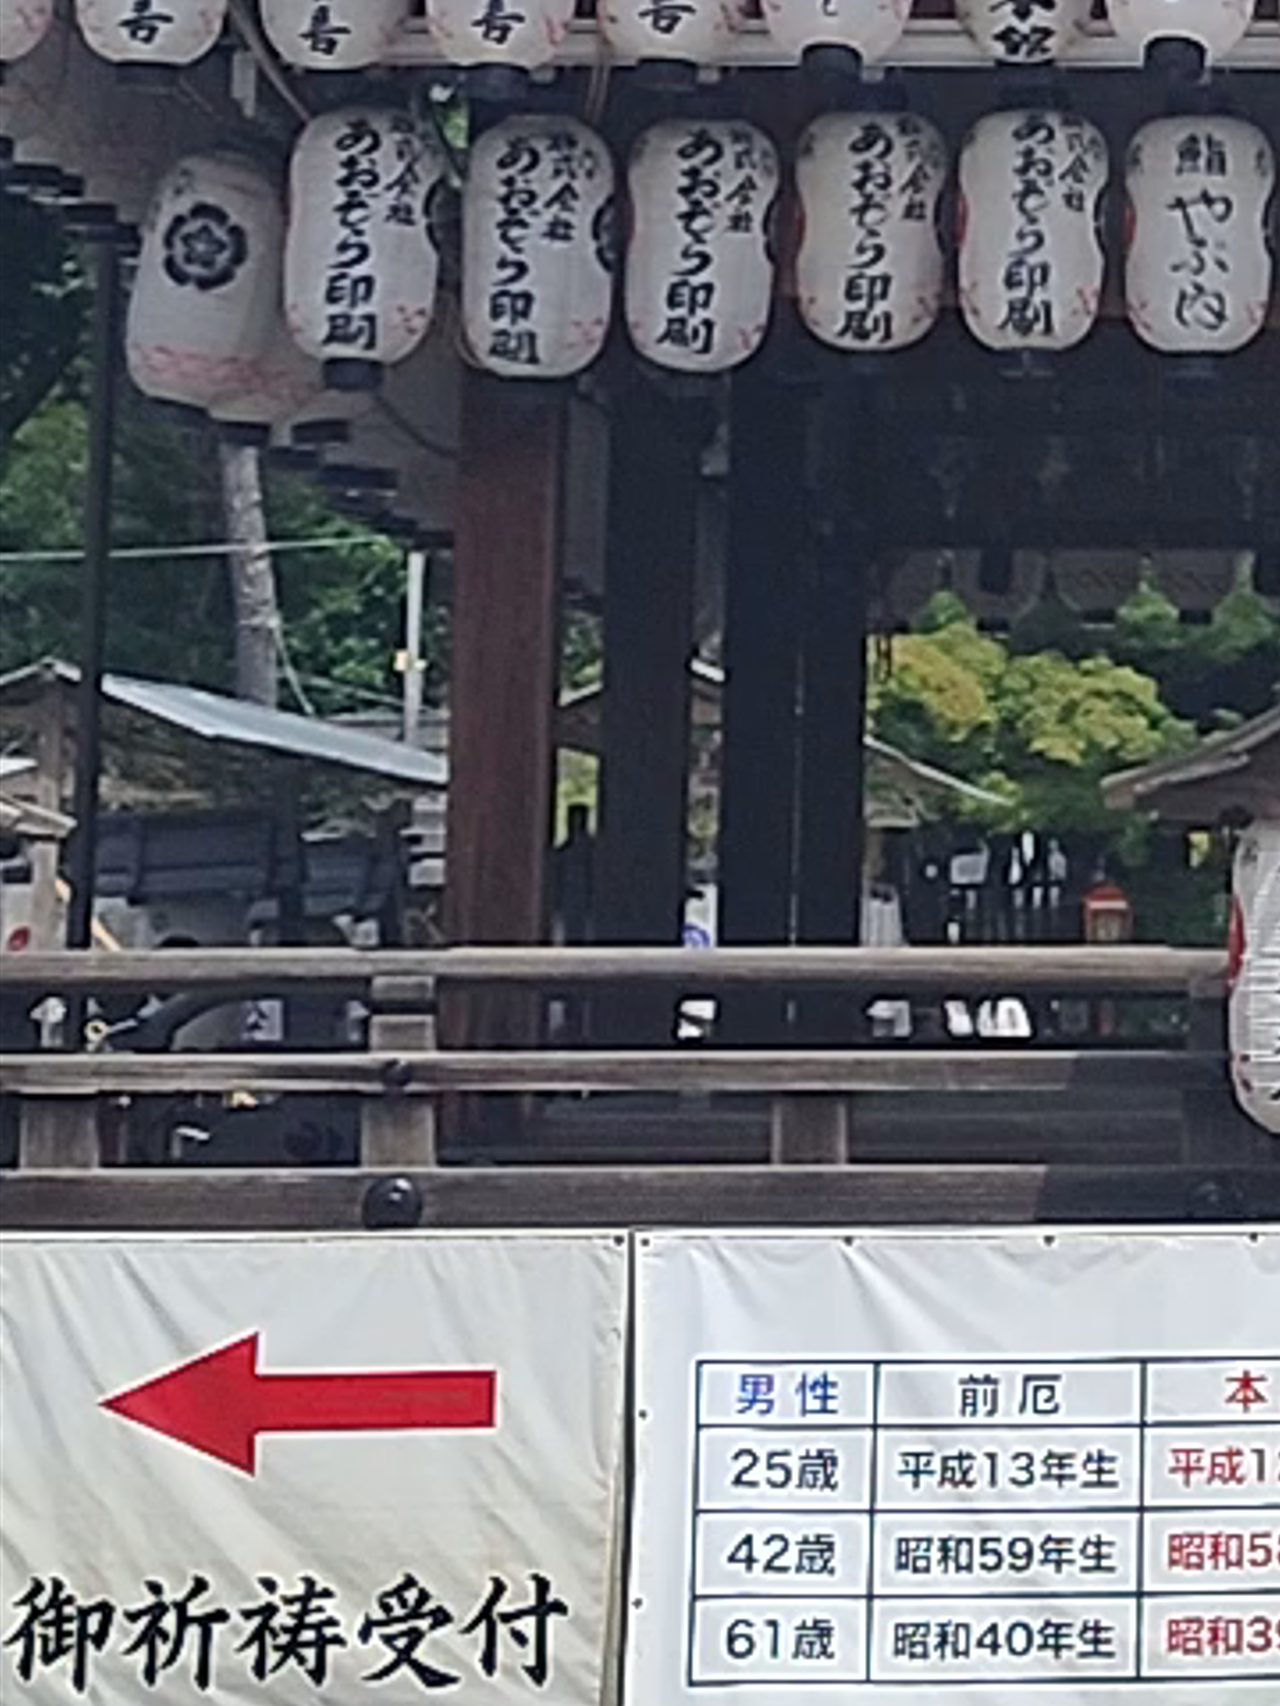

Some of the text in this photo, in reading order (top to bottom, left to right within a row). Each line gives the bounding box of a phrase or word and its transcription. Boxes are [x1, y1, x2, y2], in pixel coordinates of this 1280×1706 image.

[730, 1447, 840, 1493] 25歳
[896, 1448, 1120, 1490] 平成13年生
[726, 1532, 836, 1577] 42歳
[894, 1533, 1117, 1575] 昭和59年生
[2, 1572, 569, 1694] 御祈祷受付
[725, 1617, 836, 1661] 61歳
[892, 1618, 1117, 1662] 昭和40年生
